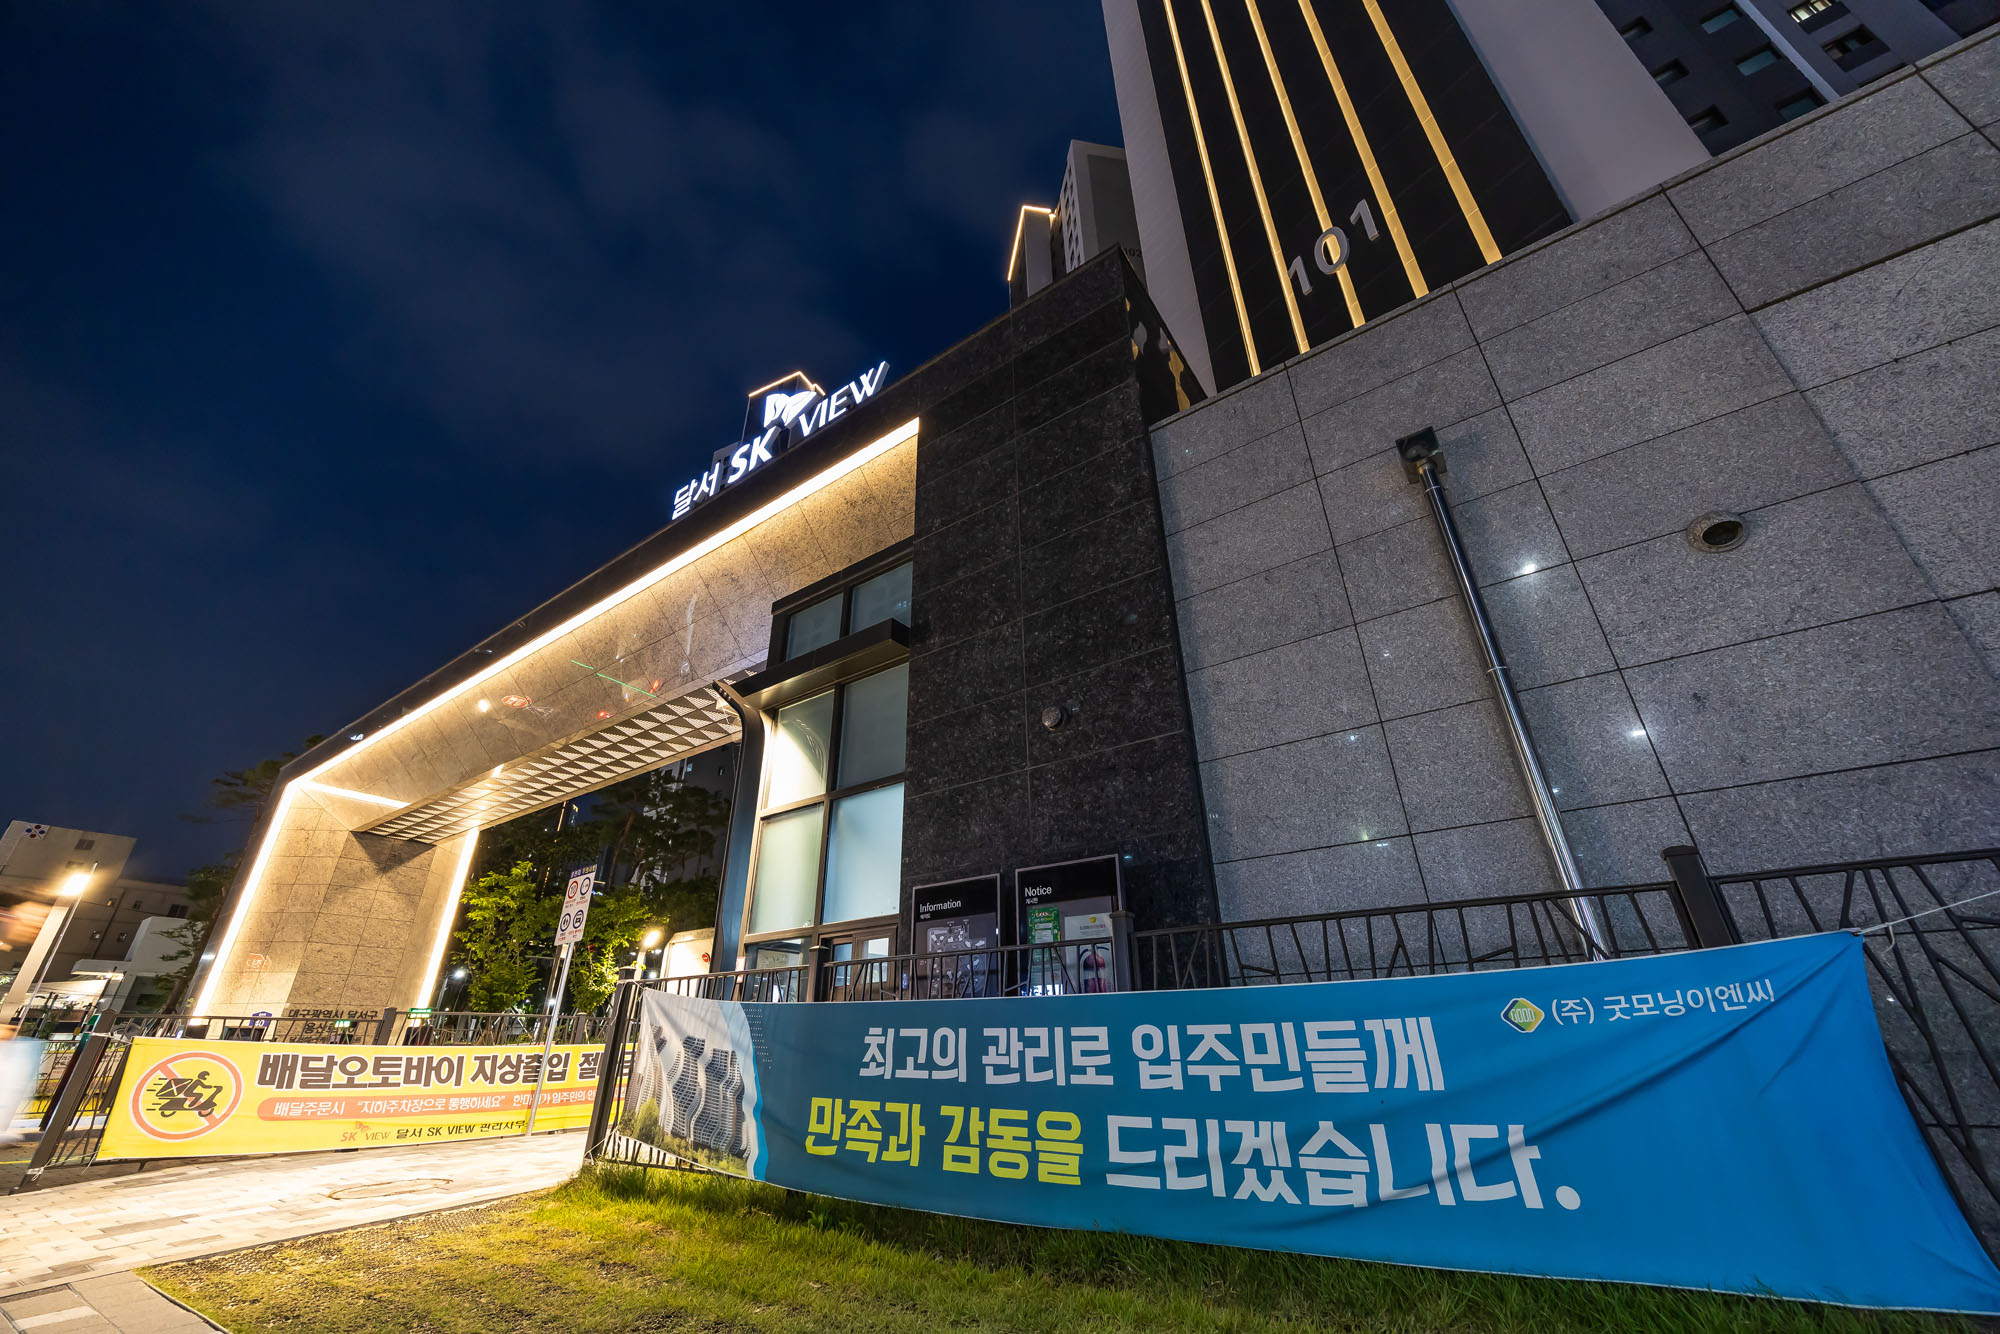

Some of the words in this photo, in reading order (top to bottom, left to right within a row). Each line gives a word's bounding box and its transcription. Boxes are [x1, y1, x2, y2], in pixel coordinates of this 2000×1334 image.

[1288, 199, 1379, 295] 101
[671, 462, 721, 520] 달서
[727, 425, 780, 484] SK
[799, 360, 890, 437] VIEW
[1024, 886, 1053, 898] Notice
[919, 899, 962, 913] Information
[288, 1008, 344, 1019] 대구광역시
[347, 1009, 379, 1019] 달서구
[1551, 997, 1595, 1026] (주)
[1602, 978, 1775, 1022] 굿모닝이엔씨
[1510, 1007, 1536, 1024] GOOD
[859, 1026, 967, 1083] 최고의
[982, 1026, 1114, 1086] 관리로
[1131, 1016, 1445, 1093] 입주민들께
[257, 1053, 465, 1090] 배달오토바이
[470, 1052, 571, 1085] 지상출입
[273, 1100, 345, 1116] 배달주문시
[512, 1093, 551, 1107] 한마가
[552, 1090, 586, 1104] 입주민의
[341, 1131, 358, 1142] SK
[365, 1131, 392, 1141] VIEW
[396, 1127, 423, 1140] 달서
[427, 1126, 443, 1137] SK
[447, 1124, 476, 1135] VIEW
[805, 1097, 926, 1167] 만족과
[940, 1105, 1084, 1186] 감동을
[1105, 1114, 1581, 1210] 드리겠습니다.
